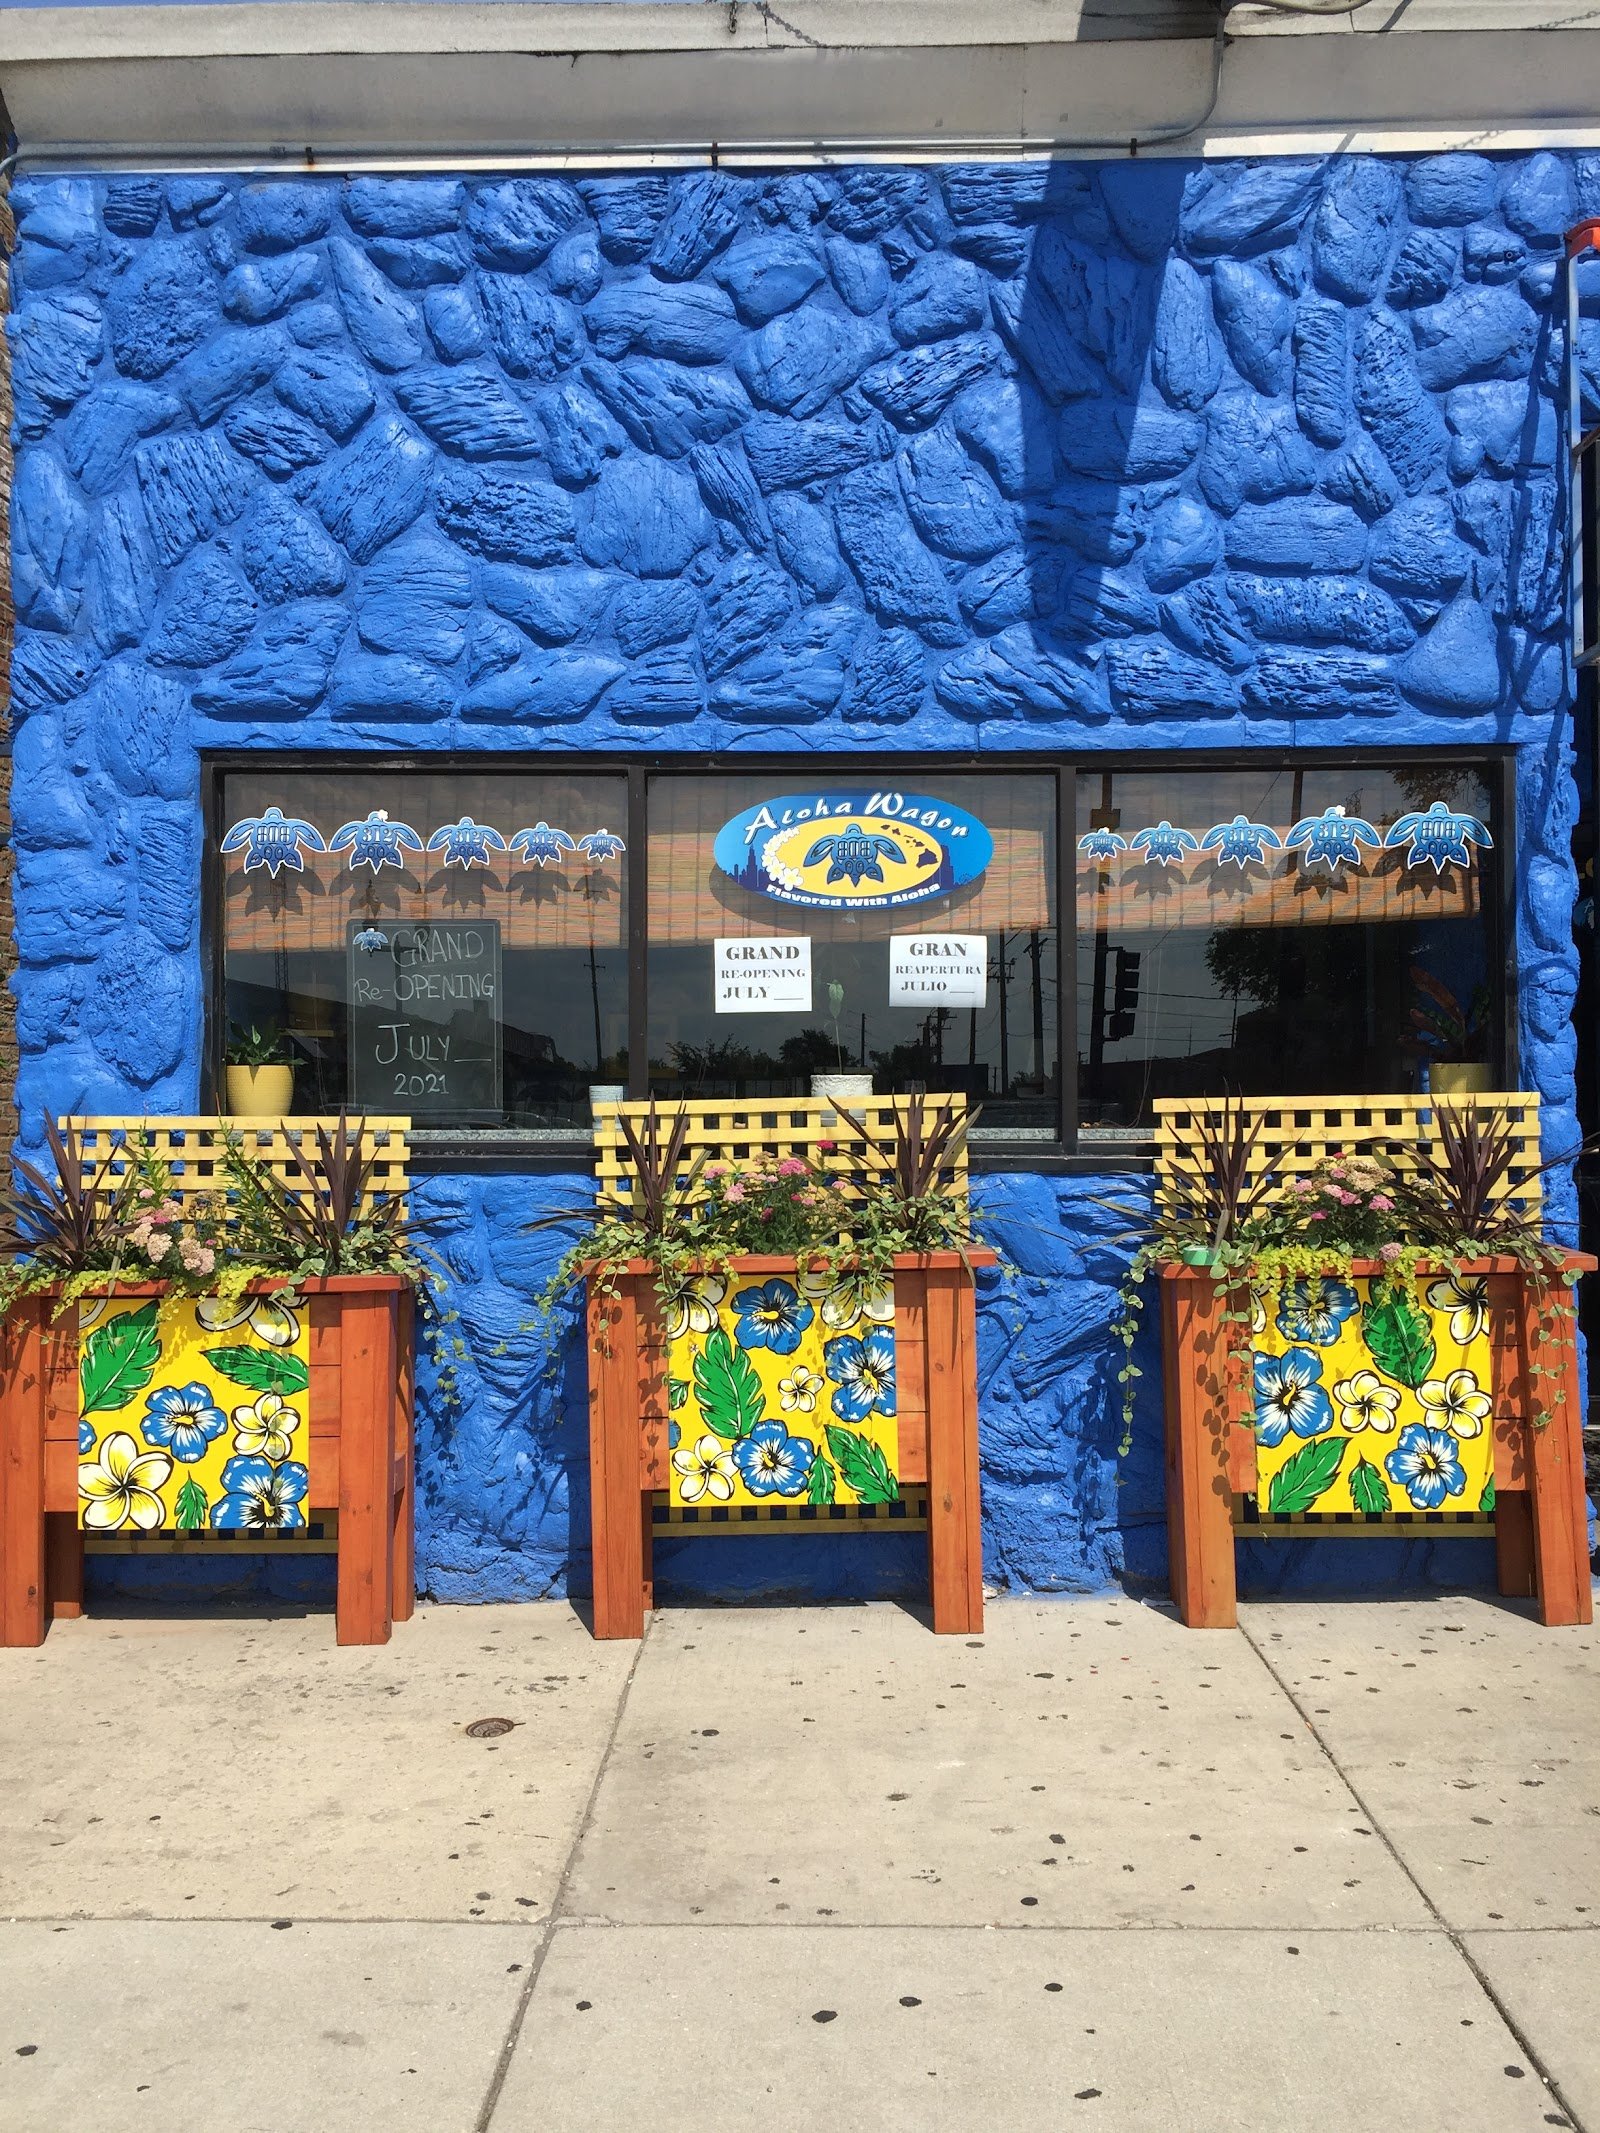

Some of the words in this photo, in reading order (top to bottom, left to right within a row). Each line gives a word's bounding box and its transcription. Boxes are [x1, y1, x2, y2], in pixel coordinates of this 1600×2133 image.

[744, 797, 853, 845] Aloha
[864, 792, 969, 838] Wagon
[363, 828, 393, 842] 312
[455, 831, 481, 843] 312
[1154, 832, 1176, 844] 312
[1229, 829, 1255, 842] 312
[1319, 824, 1350, 838] 312
[532, 833, 554, 844] 312
[766, 884, 842, 906] Flavored
[845, 897, 888, 906] With
[891, 883, 940, 905] Aloha
[391, 927, 484, 968] GRAND
[726, 946, 800, 961] GRAND
[909, 942, 968, 957] GRAN
[721, 968, 806, 979] RE-OPENING
[895, 965, 982, 975] REAPERTURA
[353, 973, 494, 1002] Re-OPENING
[723, 986, 771, 999] JULY
[901, 981, 948, 993] JULIO
[393, 1073, 450, 1096] 2021
